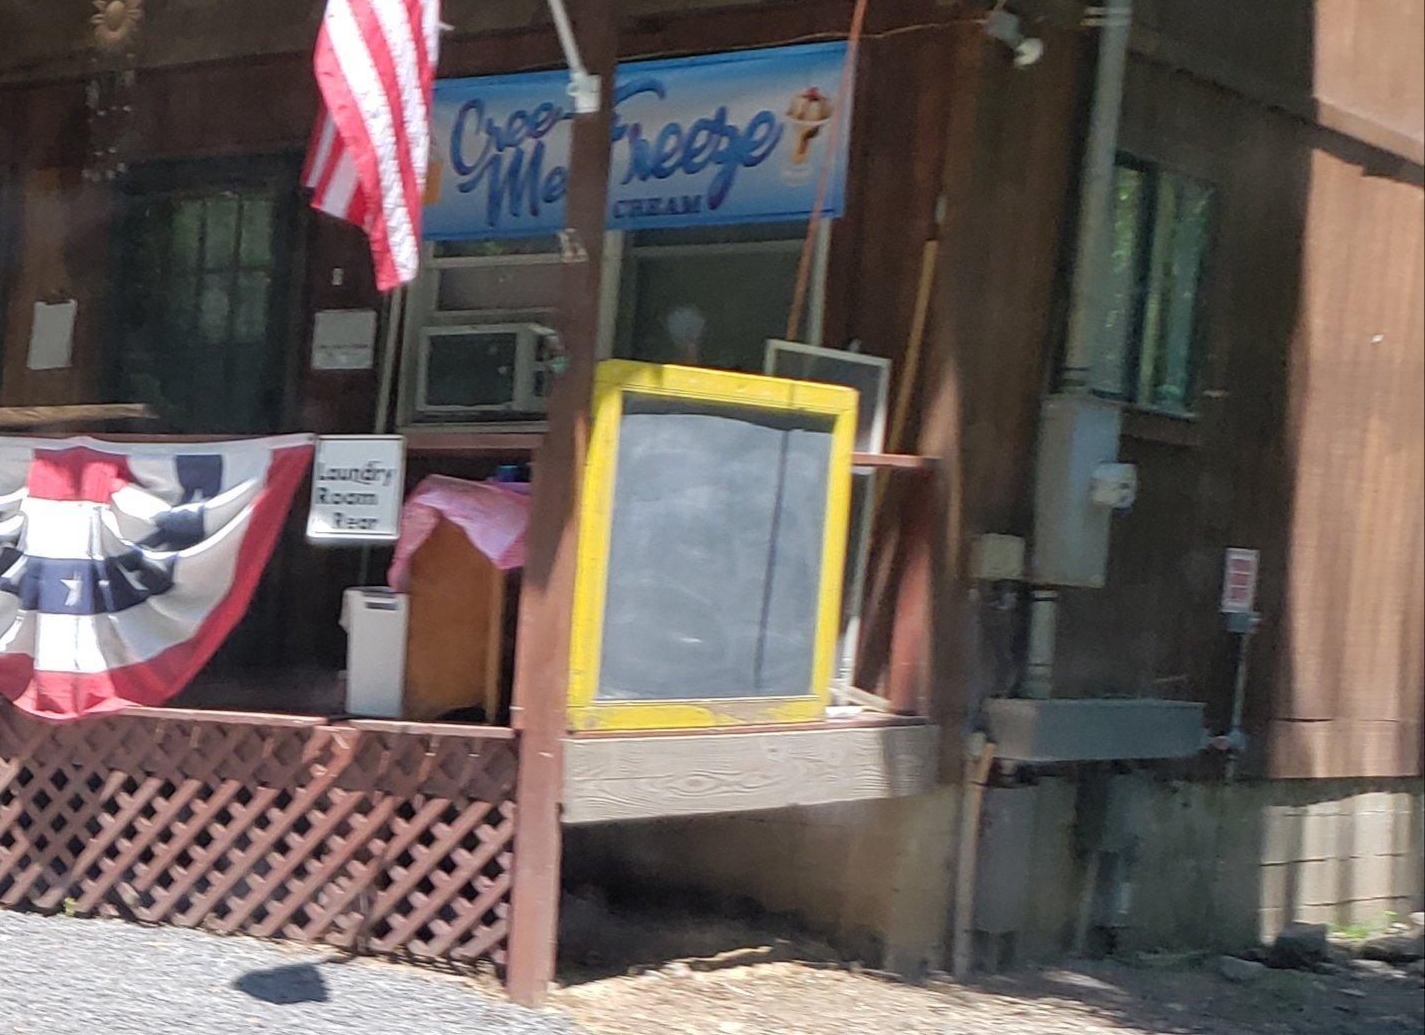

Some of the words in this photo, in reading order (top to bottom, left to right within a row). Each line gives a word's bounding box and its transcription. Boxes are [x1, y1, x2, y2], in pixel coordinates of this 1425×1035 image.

[613, 195, 703, 219] CREAM
[316, 460, 397, 486] Laundry
[316, 487, 379, 505] Room
[333, 512, 378, 530] Rear
